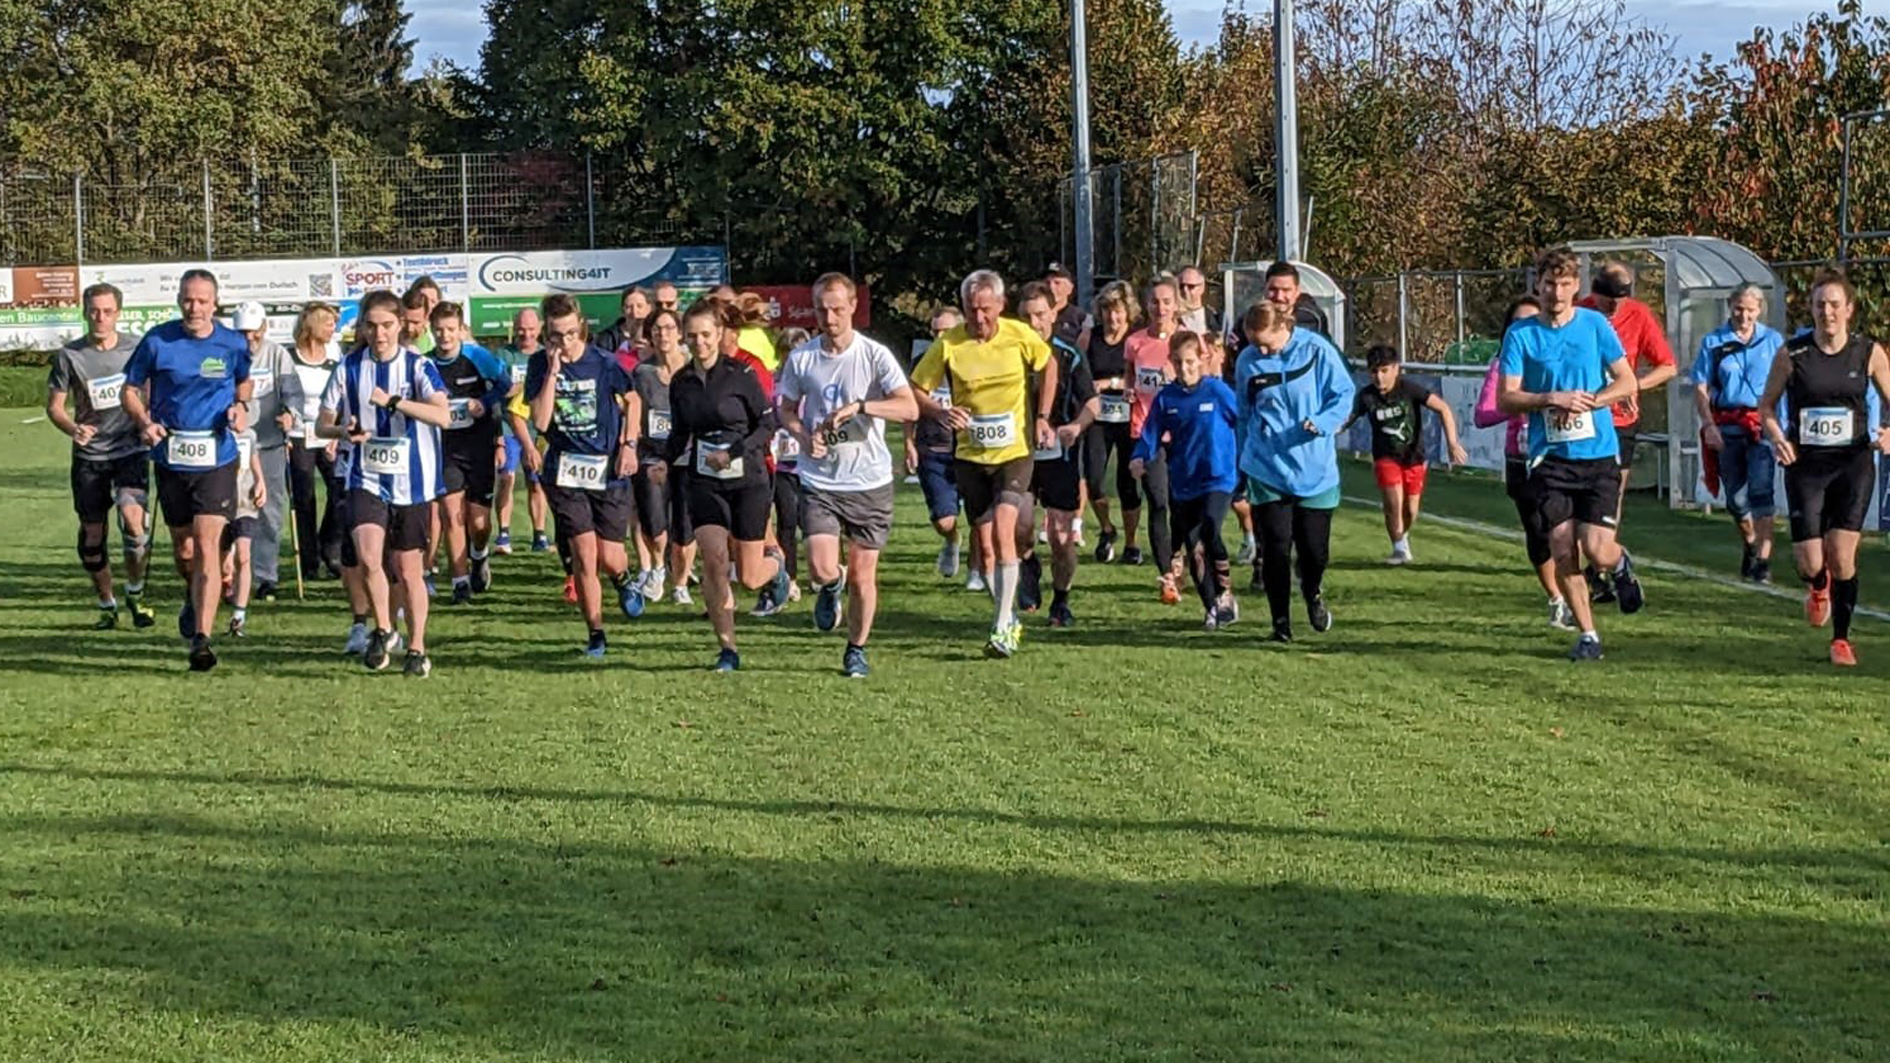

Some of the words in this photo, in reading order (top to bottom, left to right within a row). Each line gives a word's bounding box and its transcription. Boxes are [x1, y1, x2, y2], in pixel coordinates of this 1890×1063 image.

[345, 271, 394, 286] SPORT
[492, 268, 611, 282] CONSULTING4IT
[977, 425, 1007, 440] 808
[1808, 420, 1842, 436] 405
[177, 442, 207, 457] 408
[369, 448, 399, 464] 409
[567, 464, 597, 481] 410
